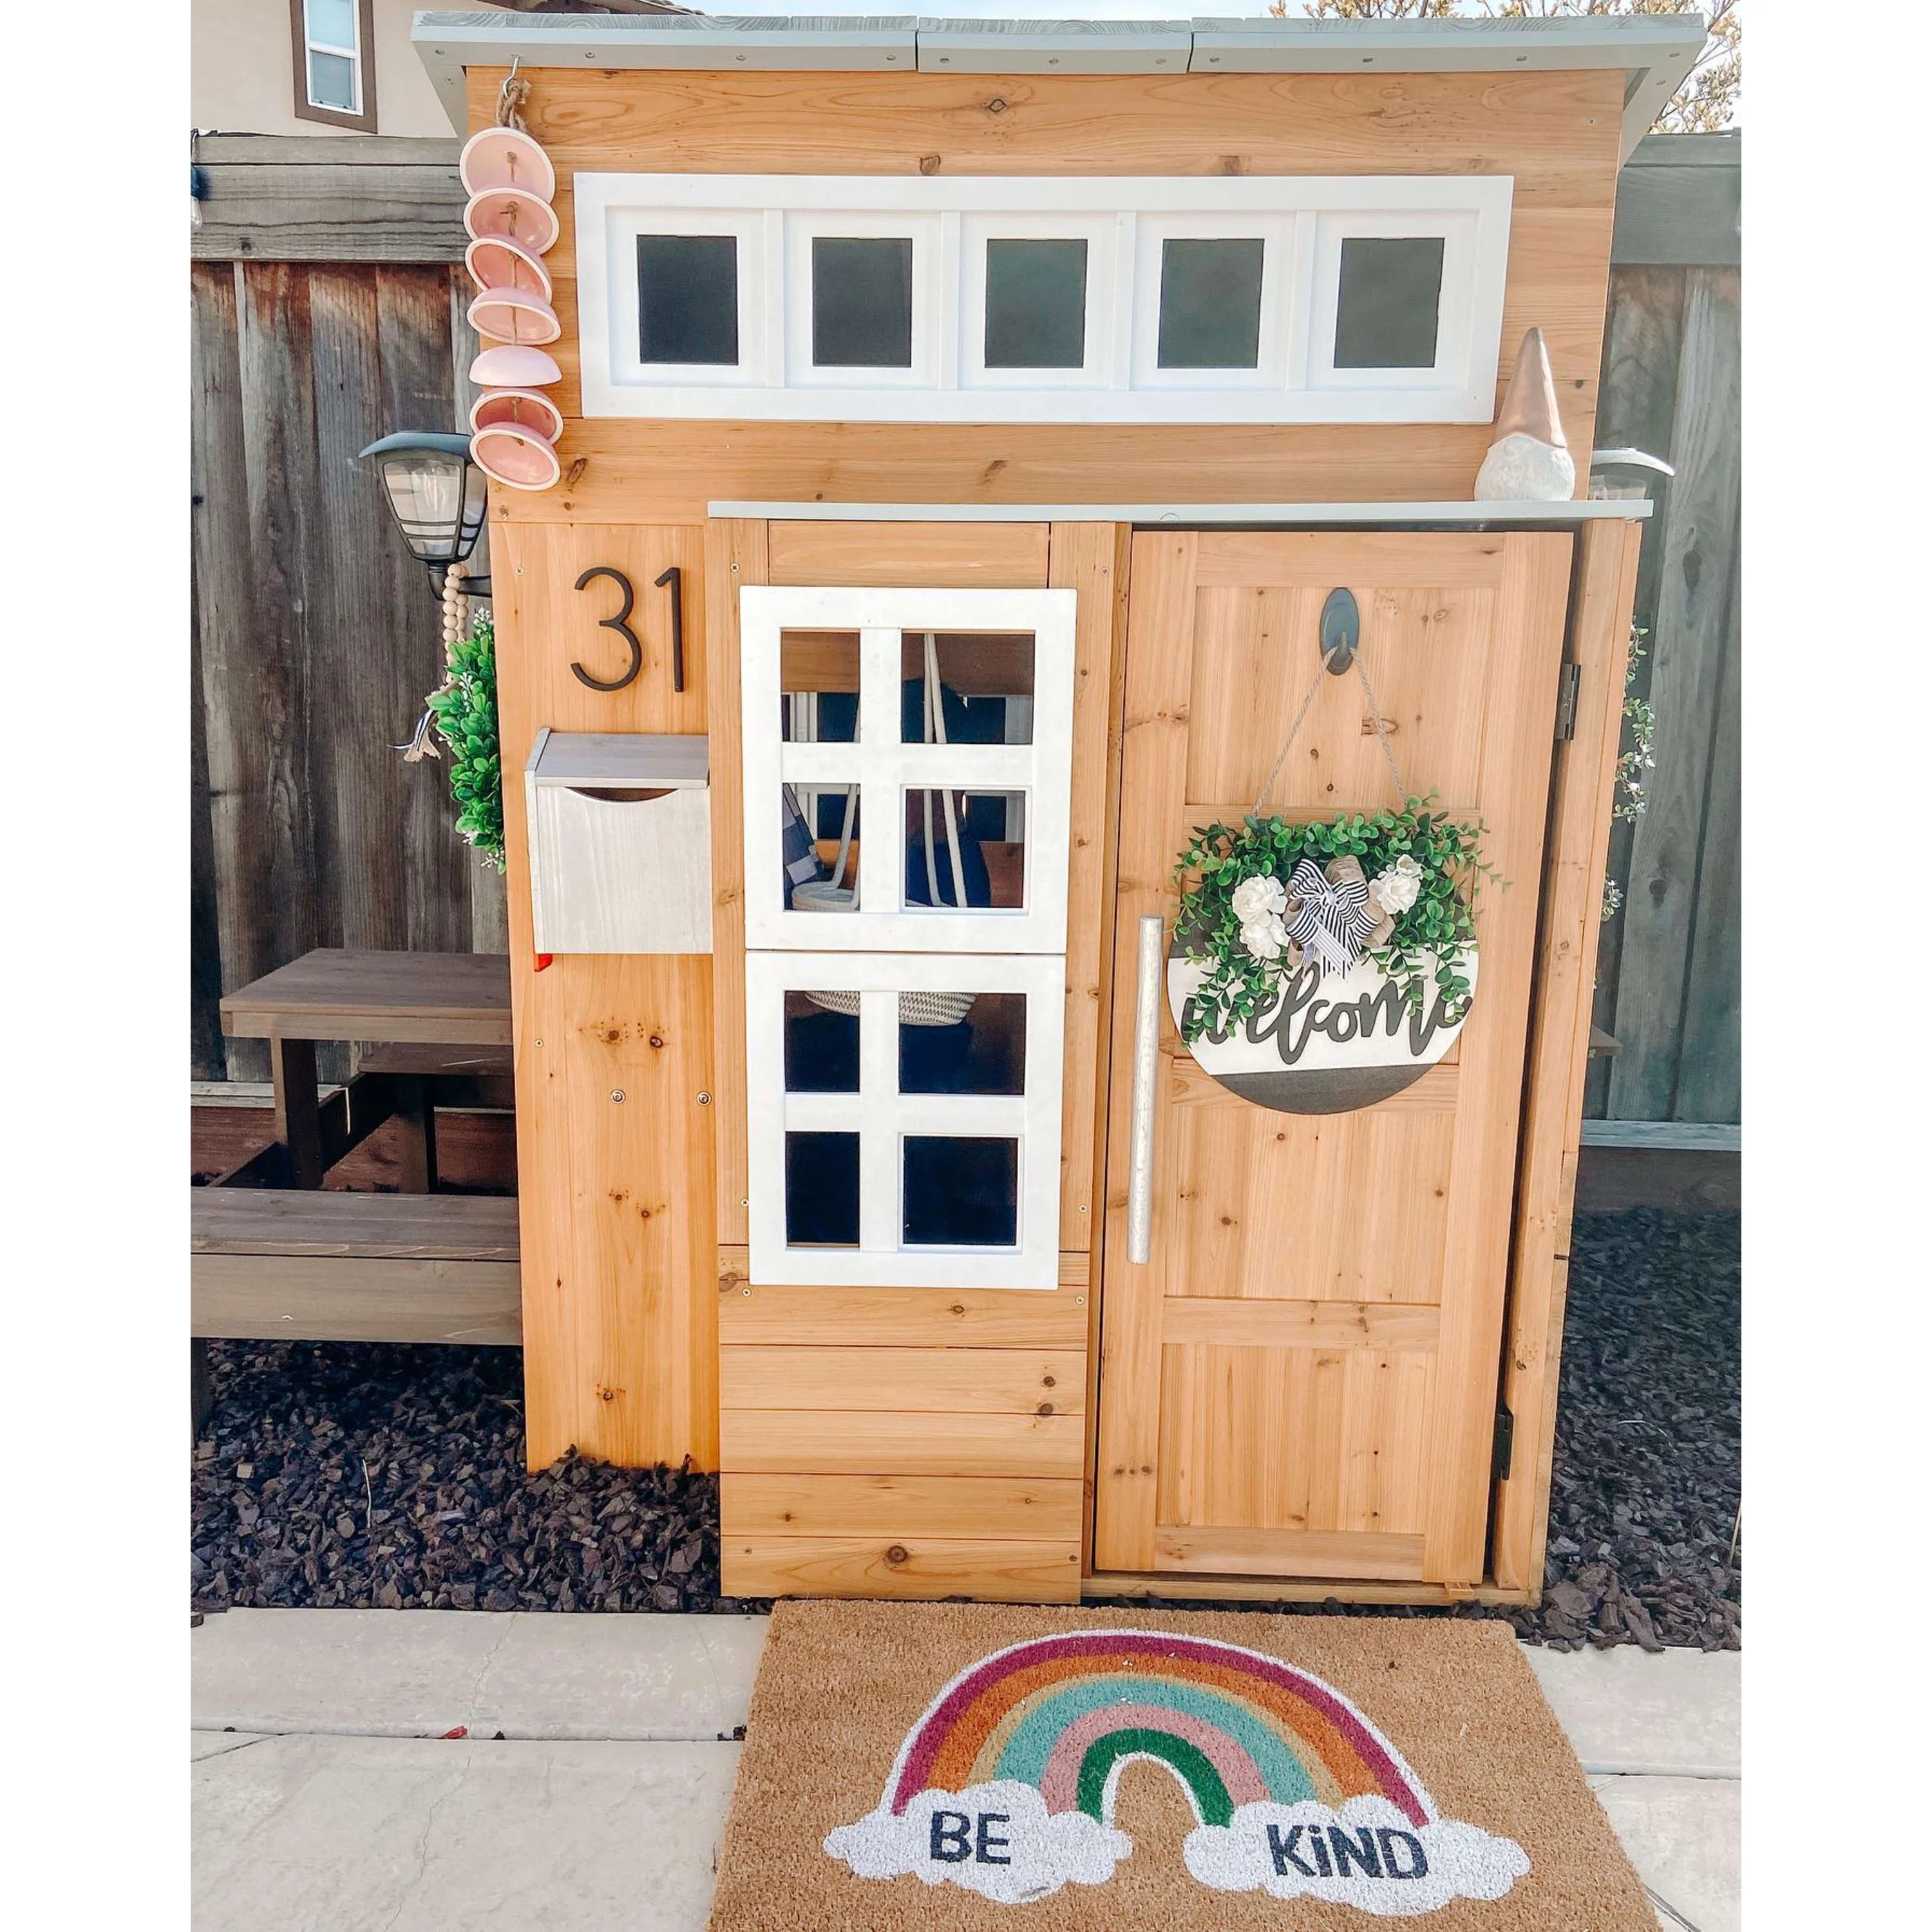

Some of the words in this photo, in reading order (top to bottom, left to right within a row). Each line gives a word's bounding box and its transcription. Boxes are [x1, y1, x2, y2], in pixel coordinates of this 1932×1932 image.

[571, 567, 684, 692] 31
[1181, 961, 1473, 1065] welcome
[931, 1811, 1011, 1864] BE
